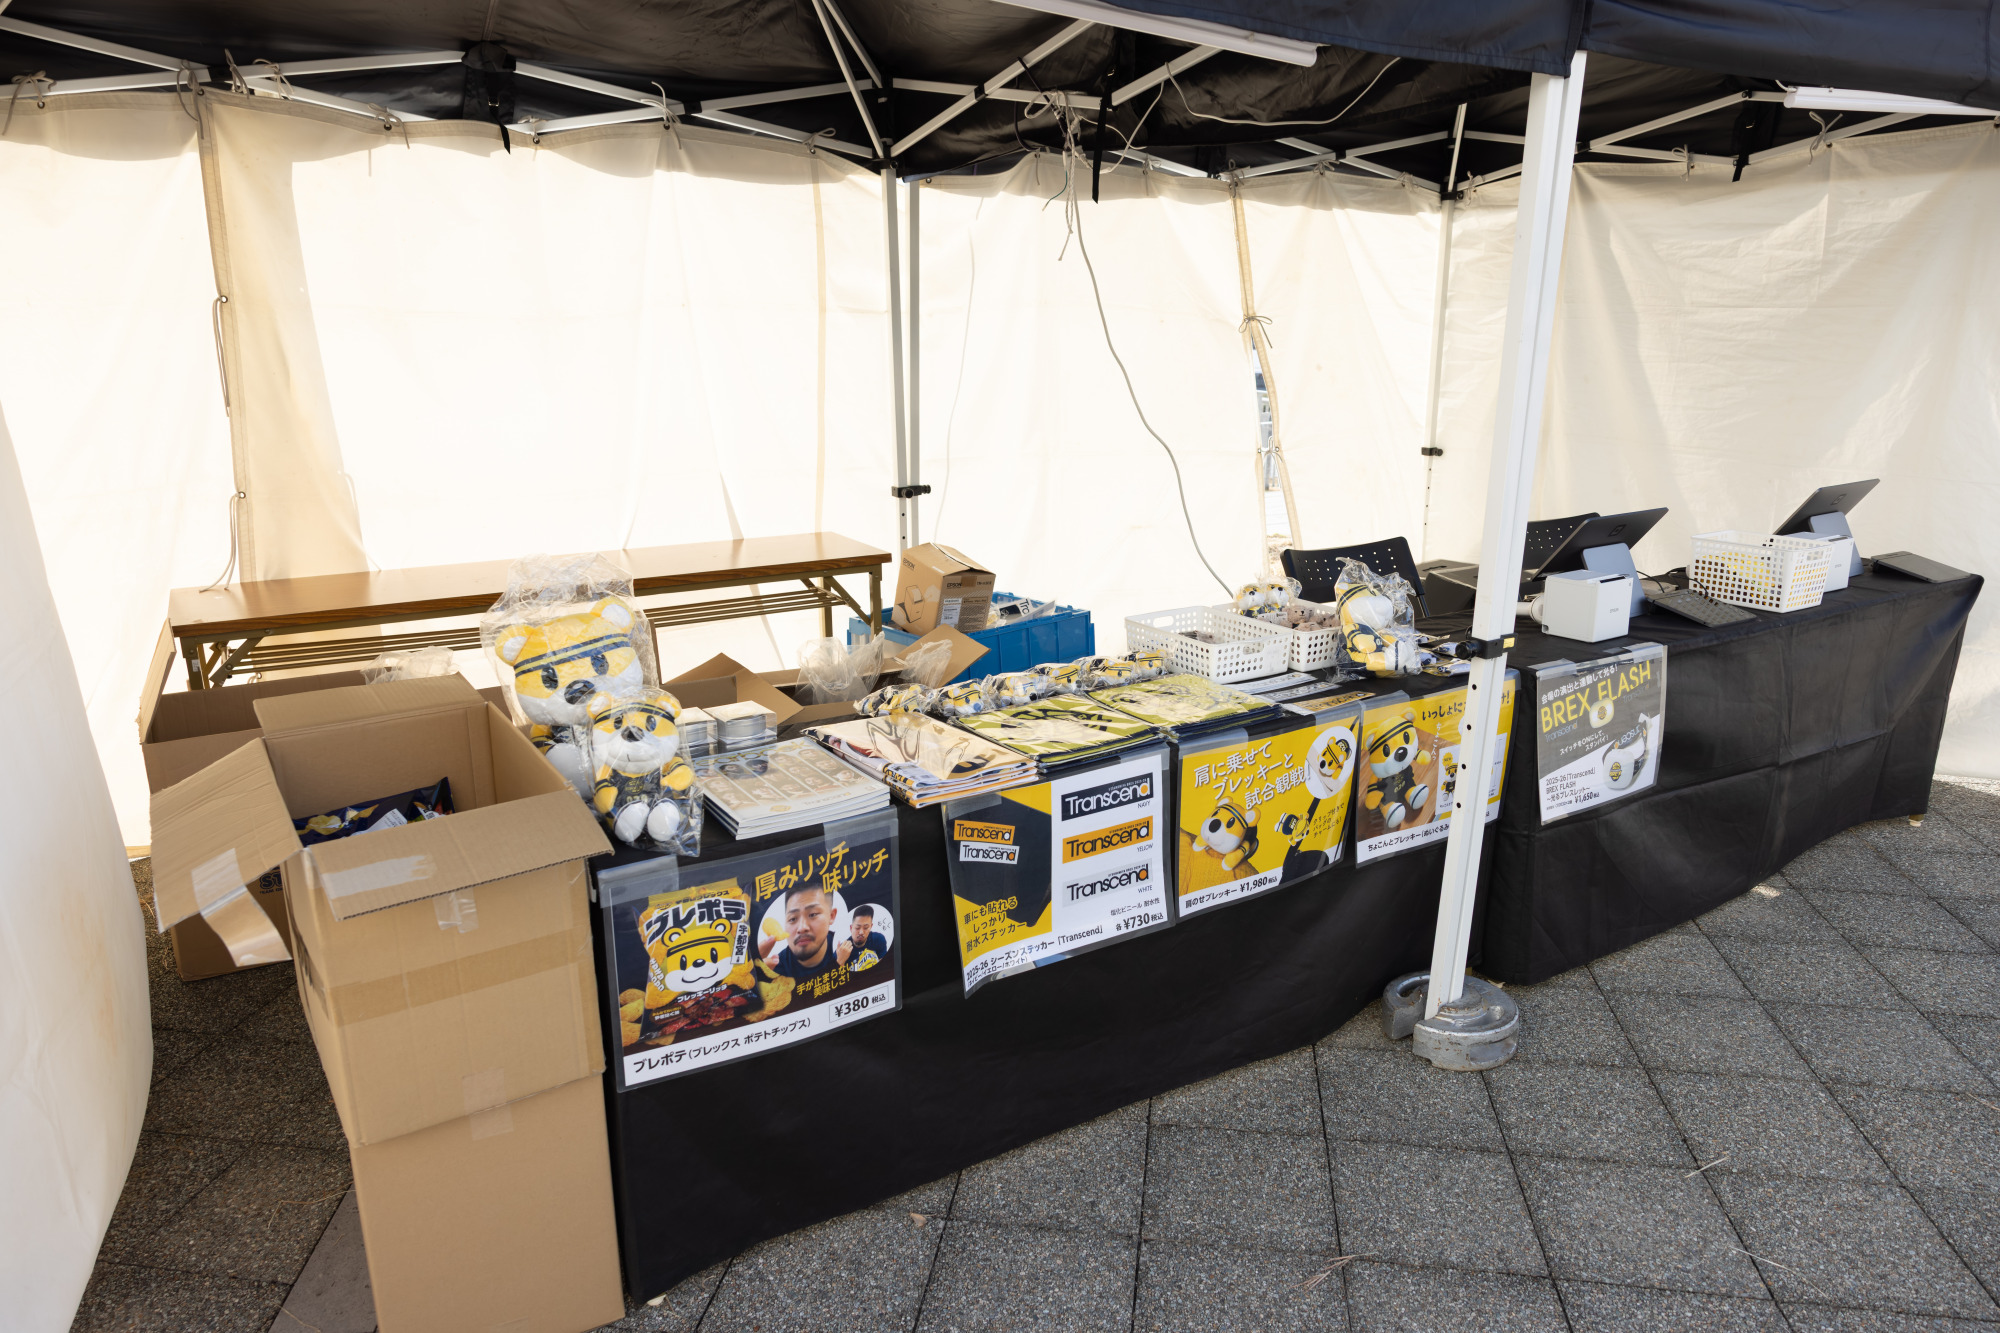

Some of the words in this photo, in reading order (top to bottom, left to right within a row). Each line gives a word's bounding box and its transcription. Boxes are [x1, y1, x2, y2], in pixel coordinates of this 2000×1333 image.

[946, 581, 963, 589] EPSON
[1422, 701, 1467, 721] いっしょに
[1541, 688, 1591, 733] BREX
[1597, 660, 1651, 702] FLASH
[1544, 720, 1578, 743] Transcend
[1194, 740, 1272, 788] 肩に乗せて
[1213, 753, 1294, 800] ブレッキーと
[1065, 778, 1150, 815] Transcend
[1244, 765, 1311, 810] 試合観戦!
[1546, 785, 1559, 794] BREX
[1559, 780, 1577, 791] FLASH
[1574, 791, 1593, 804] ¥1,650
[957, 824, 1013, 842] Transcend
[1066, 821, 1149, 857] Transcend
[1137, 843, 1154, 852] YELLOW
[963, 845, 1017, 861] Transcend
[754, 841, 850, 902] 厚みリッチ
[823, 848, 889, 893] 味リッチ
[1067, 864, 1149, 901] Transcend
[1137, 885, 1153, 894] WHITE
[1185, 889, 1238, 909] 肩のせブレッキー
[1239, 877, 1268, 893] ¥1,980
[643, 898, 746, 948] ブレポテ
[964, 898, 1017, 925] 車にも貼れる
[973, 913, 1006, 934] しっかり
[1123, 913, 1150, 930] ¥730
[1150, 911, 1164, 922] 税込
[966, 923, 1026, 953] 耐水ステッカー
[966, 960, 989, 981] 2025-26
[990, 941, 1055, 966] シーズンステッカー
[796, 961, 855, 995] 手が止まらない
[834, 996, 869, 1018] ¥380
[871, 994, 886, 1004] 税込
